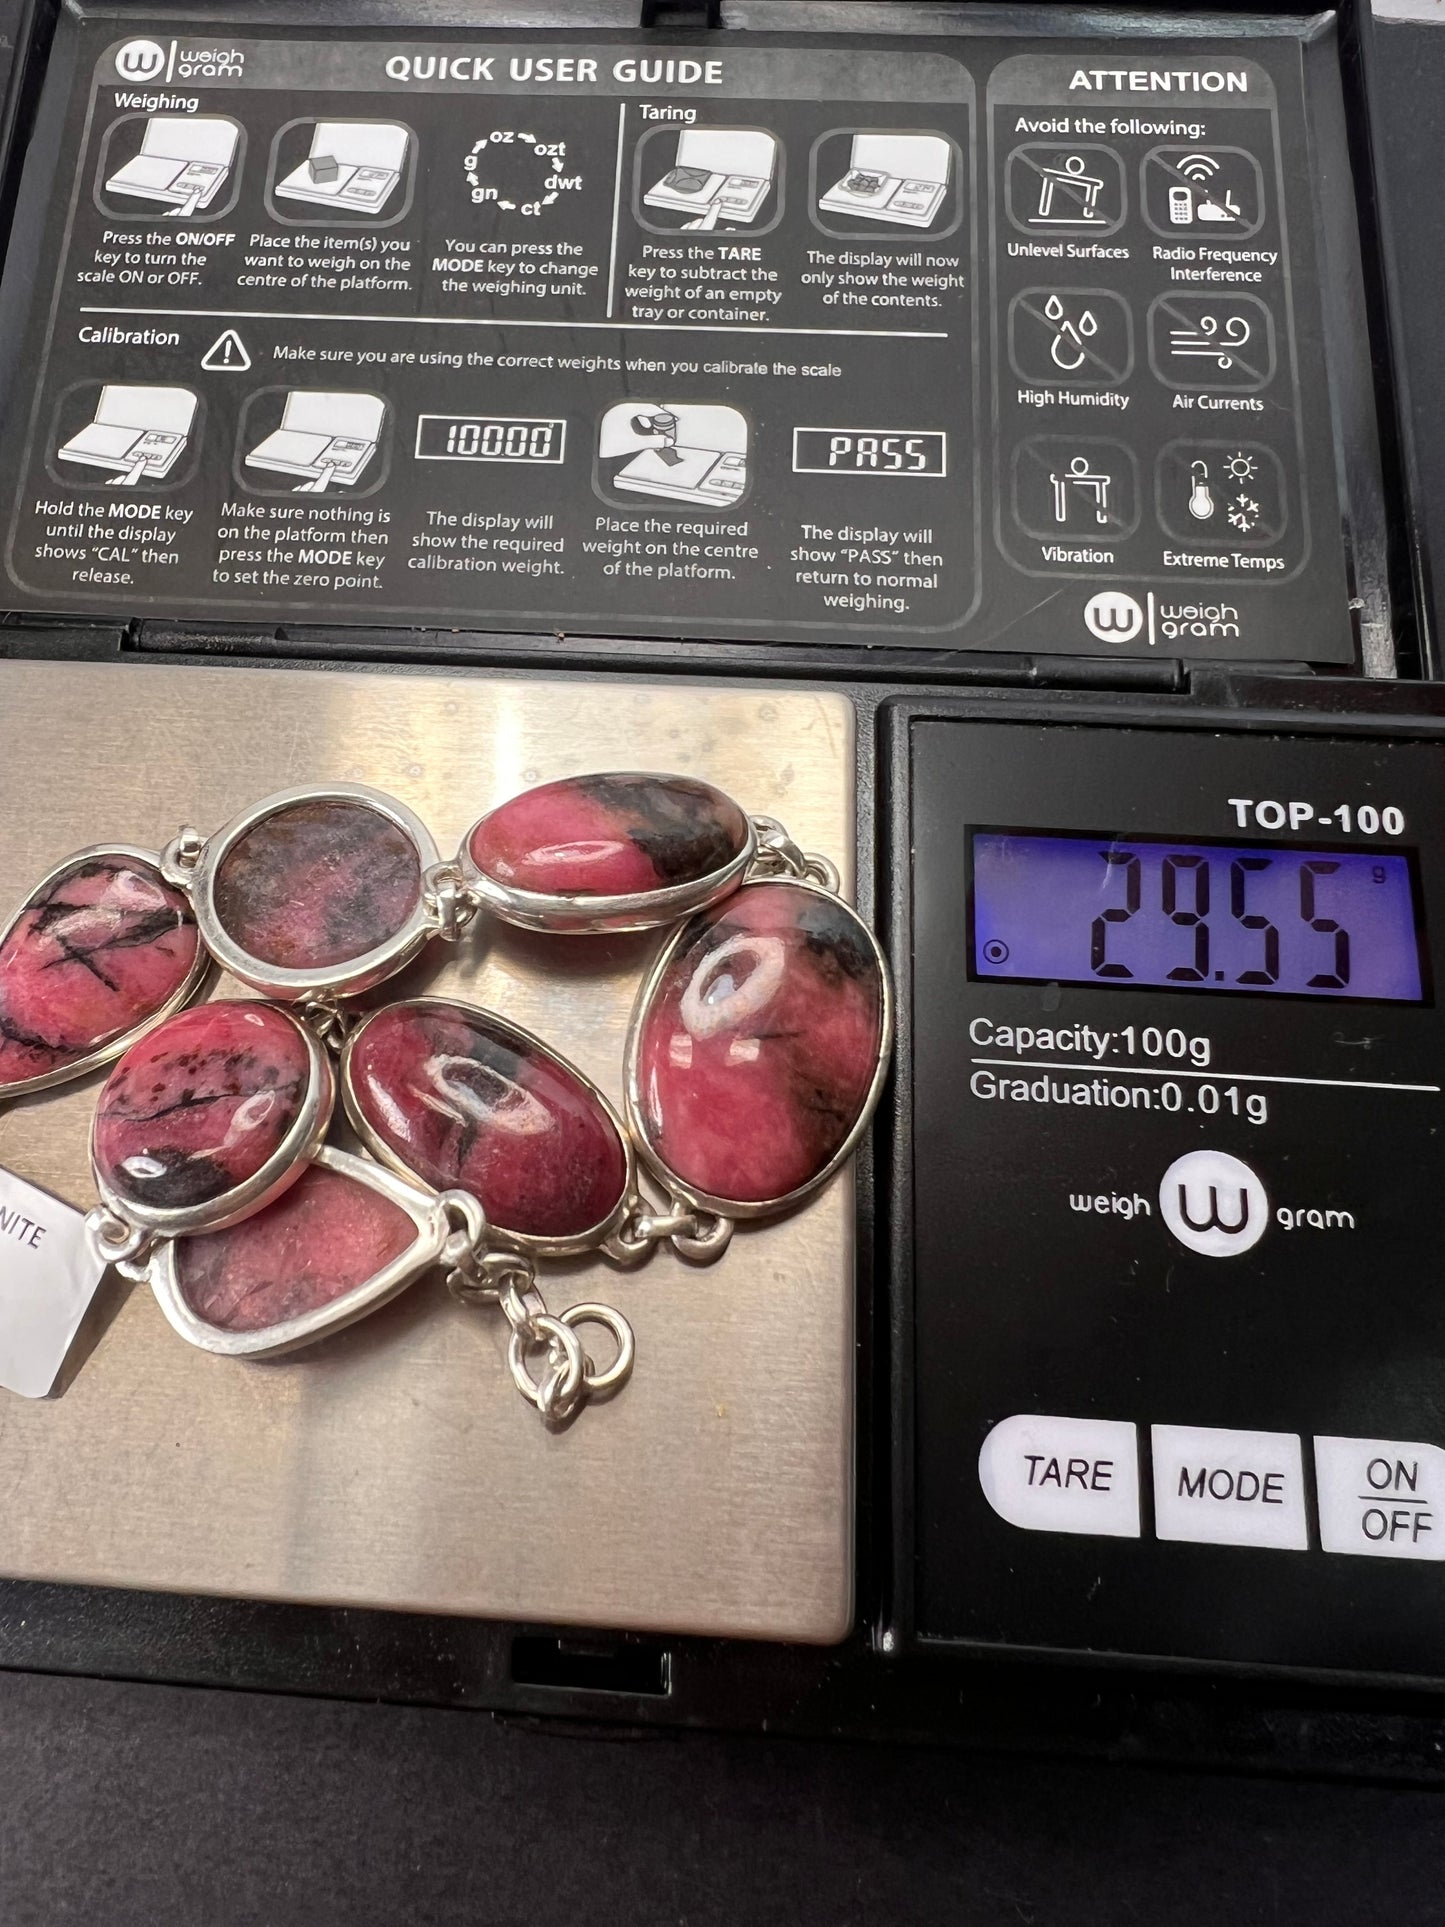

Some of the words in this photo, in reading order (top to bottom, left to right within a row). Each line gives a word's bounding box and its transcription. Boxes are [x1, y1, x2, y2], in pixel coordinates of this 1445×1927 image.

[180, 48, 245, 67] weigh
[178, 62, 243, 79] gram
[386, 56, 494, 81] QUICK
[510, 59, 597, 81] USER
[613, 60, 722, 84] GUIDE
[1069, 70, 1247, 92] ATTENTION
[115, 93, 199, 112] Weighing
[639, 105, 696, 124] Taring
[490, 131, 514, 143] oz
[1015, 118, 1069, 132] Avoid
[1074, 118, 1106, 133] the
[1110, 119, 1205, 139] following:
[534, 142, 566, 156] ozt
[464, 156, 477, 170] g
[545, 174, 582, 190] dwt
[472, 188, 498, 203] gn
[521, 201, 541, 215] ct
[103, 231, 142, 244] Press
[147, 232, 171, 245] the
[176, 232, 235, 246] ON/OFF
[250, 234, 290, 247] Place
[295, 235, 320, 248] the
[324, 236, 377, 251] item(s)
[381, 241, 410, 253] you
[446, 239, 475, 252] You
[480, 243, 507, 253] can
[511, 244, 552, 257] press
[557, 242, 583, 255] the
[95, 250, 121, 266] key
[125, 252, 140, 263] to
[145, 253, 176, 264] turn
[182, 252, 206, 265] the
[643, 245, 683, 258] Press
[688, 246, 714, 259] the
[718, 247, 761, 260] TARE
[807, 251, 835, 264] The
[839, 252, 892, 268] display
[896, 253, 921, 266] will
[926, 257, 959, 267] now
[1008, 243, 1063, 257] Unlevel
[1067, 244, 1129, 258] Surfaces
[1153, 246, 1195, 260] Radio
[1199, 247, 1277, 265] Frequency
[245, 255, 283, 266] want
[288, 256, 304, 267] to
[308, 256, 355, 273] weigh
[360, 260, 380, 269] on
[385, 257, 410, 270] the
[432, 258, 483, 272] MODE
[488, 260, 515, 276] key
[519, 262, 535, 273] to
[540, 262, 598, 278] change
[629, 264, 656, 280] key
[660, 267, 676, 278] to
[681, 266, 747, 280] subtract
[752, 268, 777, 281] the
[77, 270, 115, 282] scale
[119, 270, 144, 283] ON
[148, 274, 164, 283] or
[168, 272, 201, 285] OFF.
[238, 274, 287, 286] centre
[290, 274, 308, 286] of
[311, 275, 336, 288] the
[341, 276, 412, 291] platform.
[802, 271, 834, 287] only
[839, 272, 878, 285] show
[882, 273, 907, 286] the
[912, 274, 964, 290] weight
[1171, 267, 1262, 282] Interference
[625, 285, 681, 301] weight
[684, 286, 702, 299] of
[705, 290, 724, 299] an
[729, 289, 782, 304] empty
[79, 327, 179, 345] Calibration
[274, 346, 316, 360] Make
[320, 351, 353, 361] sure
[357, 352, 386, 365] you
[391, 353, 415, 363] are
[420, 352, 462, 368] using
[467, 352, 493, 365] the
[497, 356, 553, 368] correct
[558, 356, 620, 372] weights
[626, 358, 665, 371] when
[671, 363, 698, 375] you
[704, 361, 767, 374] calibrate
[773, 362, 796, 375] the
[802, 364, 841, 376] scale
[1018, 390, 1054, 407] High
[1059, 391, 1129, 410] Humidity
[1173, 395, 1194, 408] Air
[1198, 395, 1264, 410] Currents
[829, 437, 925, 470] PASS
[35, 501, 74, 515] Hold
[79, 502, 104, 517] the
[108, 504, 161, 519] MODE
[165, 505, 193, 524] key
[221, 503, 265, 517] Make
[270, 508, 304, 519] sure
[309, 507, 373, 525] nothing
[379, 509, 390, 522] is
[427, 511, 457, 526] The
[462, 513, 520, 531] display
[525, 515, 553, 529] will
[47, 524, 83, 537] until
[88, 524, 114, 539] the
[119, 526, 176, 545] display
[218, 528, 238, 538] on
[245, 525, 270, 540] the
[275, 527, 345, 543] platform
[352, 529, 388, 544] then
[596, 517, 639, 532] Place
[645, 519, 671, 533] the
[677, 522, 748, 537] required
[801, 525, 833, 540] The
[838, 526, 899, 545] display
[903, 529, 932, 543] will
[219, 550, 261, 563] press
[268, 548, 293, 563] the
[299, 549, 352, 565] MODE
[357, 551, 385, 569] key
[583, 540, 641, 556] weight
[646, 544, 666, 554] on
[673, 542, 700, 556] the
[705, 545, 758, 558] centre
[1042, 546, 1113, 563] Vibration
[408, 555, 496, 571] calibration
[502, 559, 564, 576] weight.
[1164, 551, 1228, 567] Extreme
[1231, 553, 1284, 572] Temps
[73, 568, 133, 584] release.
[796, 571, 848, 585] return
[854, 572, 871, 585] to
[877, 574, 937, 588] normal
[824, 593, 909, 613] weighing.
[1160, 602, 1238, 624] weigh
[1161, 621, 1240, 639] gram
[1228, 799, 1404, 835] TOP-100
[1091, 852, 1350, 989] 29.55
[1372, 865, 1386, 884] g
[1070, 1192, 1150, 1220] weigh
[1277, 1208, 1354, 1230] gram
[1024, 1456, 1113, 1491] TARE
[1367, 1459, 1418, 1491] ON
[1179, 1467, 1284, 1503] MODE
[1362, 1509, 1432, 1542] OFF
